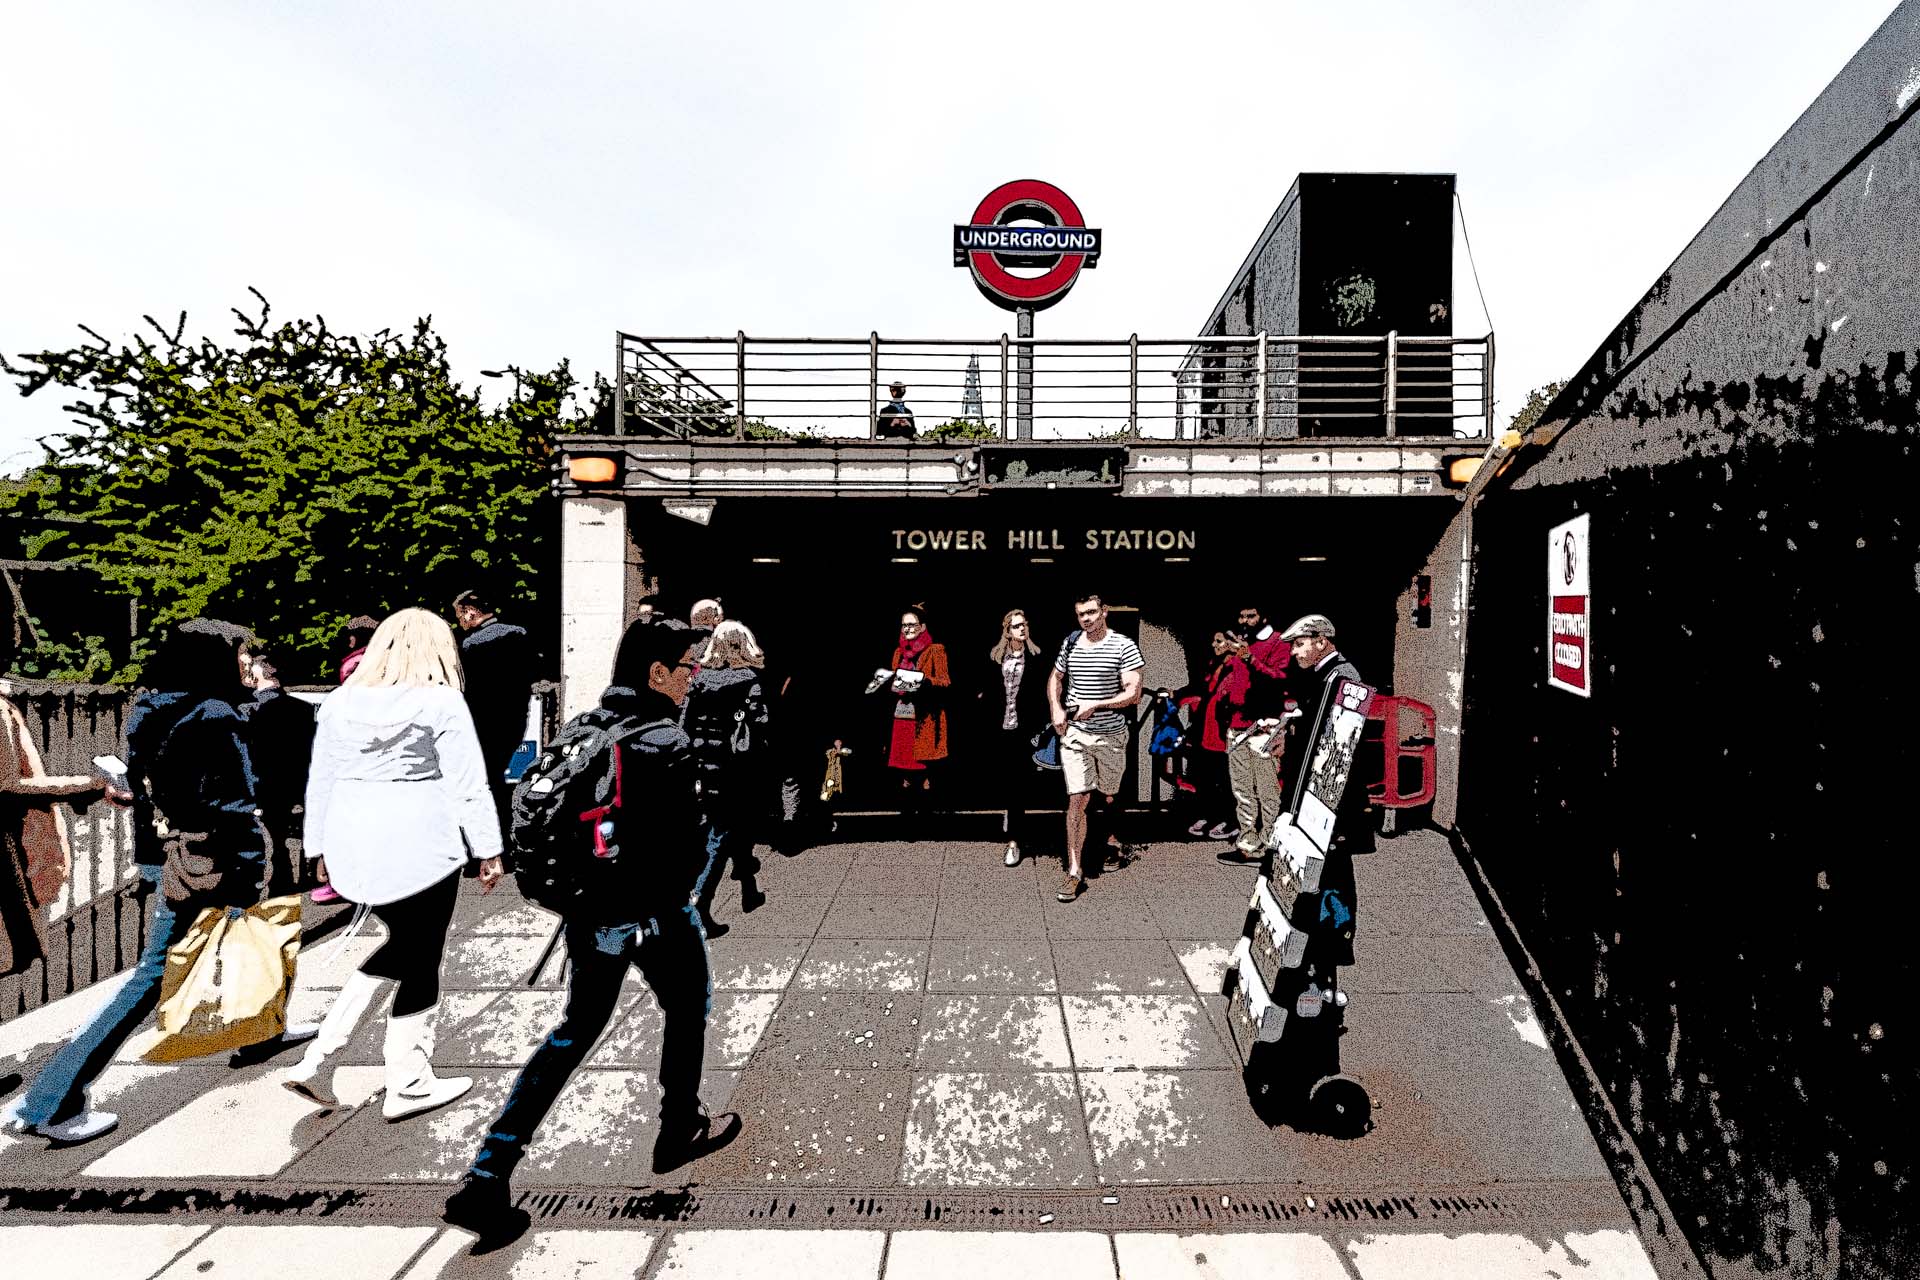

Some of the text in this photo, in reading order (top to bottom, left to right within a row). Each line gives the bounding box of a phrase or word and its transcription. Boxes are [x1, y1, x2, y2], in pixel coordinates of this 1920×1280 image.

[960, 230, 1096, 249] UNDERGROUND
[892, 529, 1196, 550] TOWER HILL STATION
